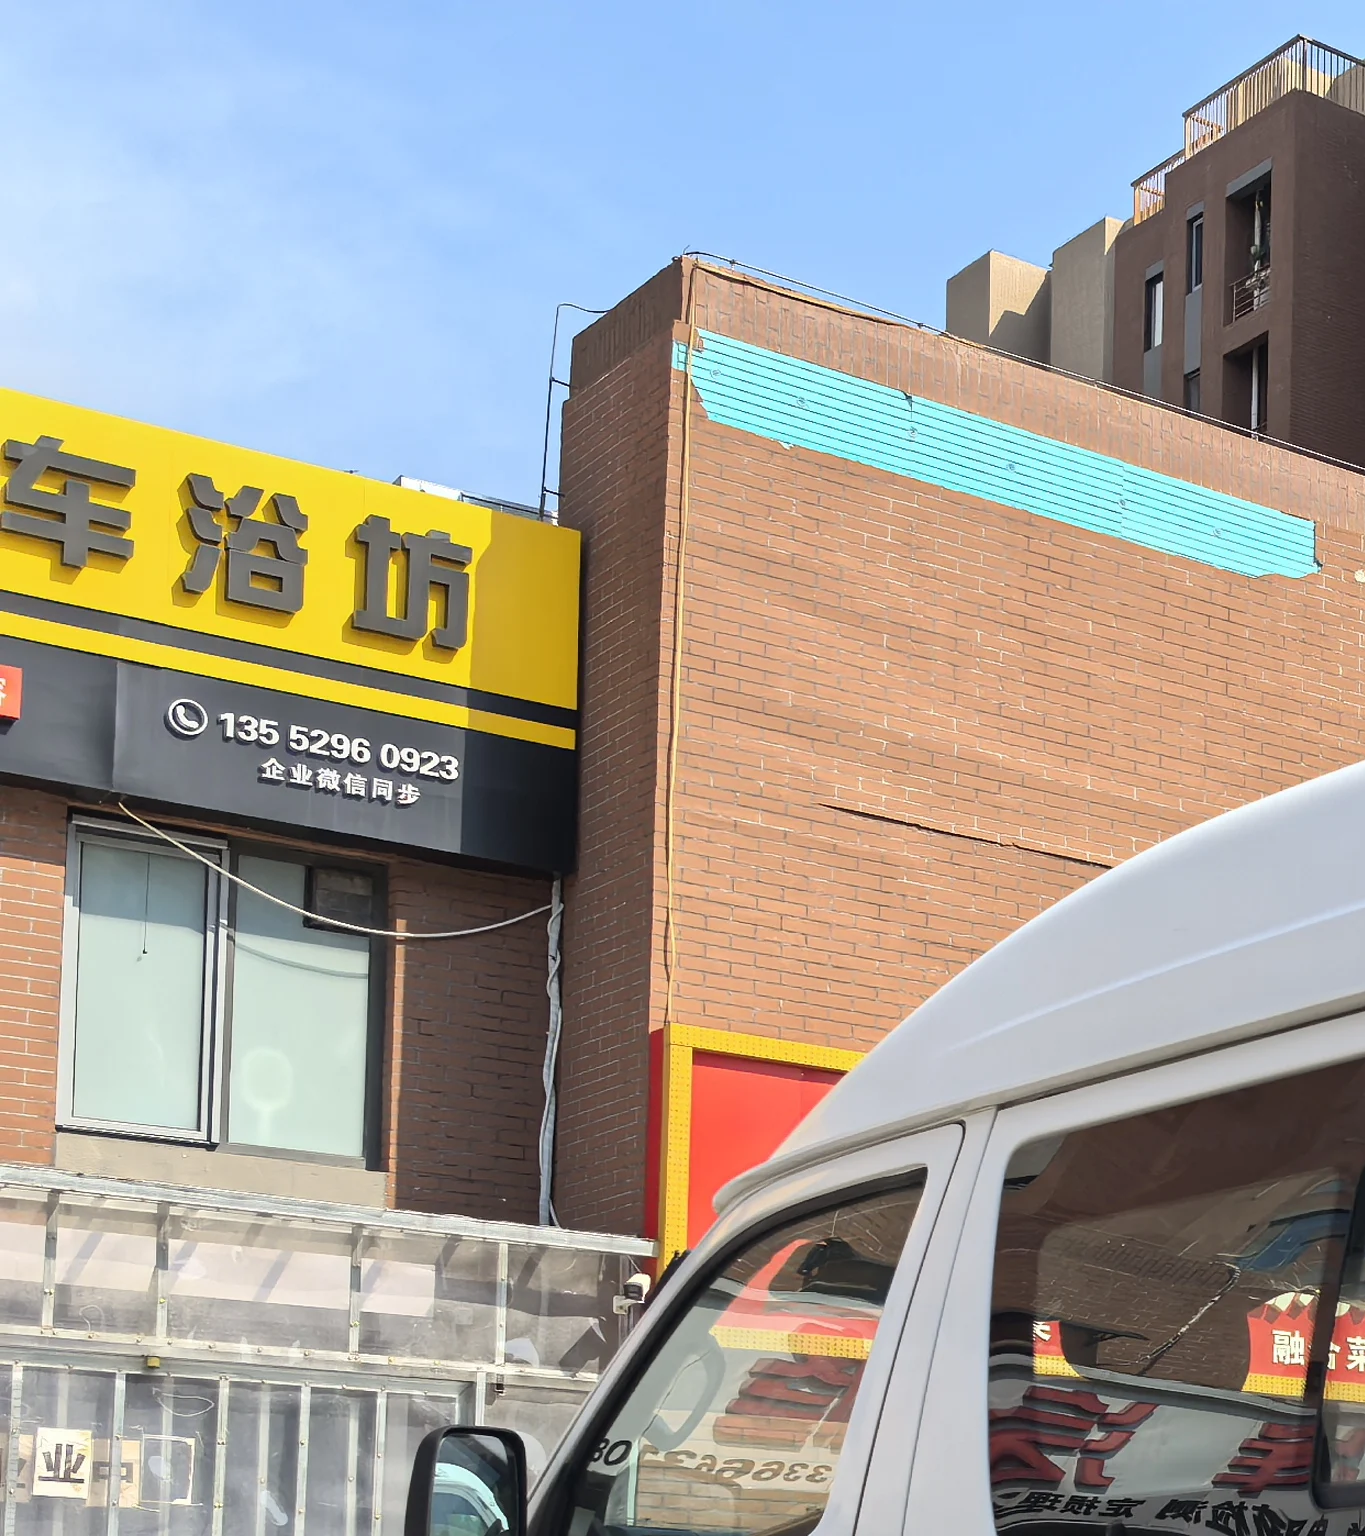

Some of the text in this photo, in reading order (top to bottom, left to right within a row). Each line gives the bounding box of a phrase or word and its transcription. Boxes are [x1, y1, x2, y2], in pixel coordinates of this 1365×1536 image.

[1, 435, 473, 649] 车浴坊
[219, 712, 460, 781] 135 5296 0923
[261, 757, 421, 805] 企业微信同步
